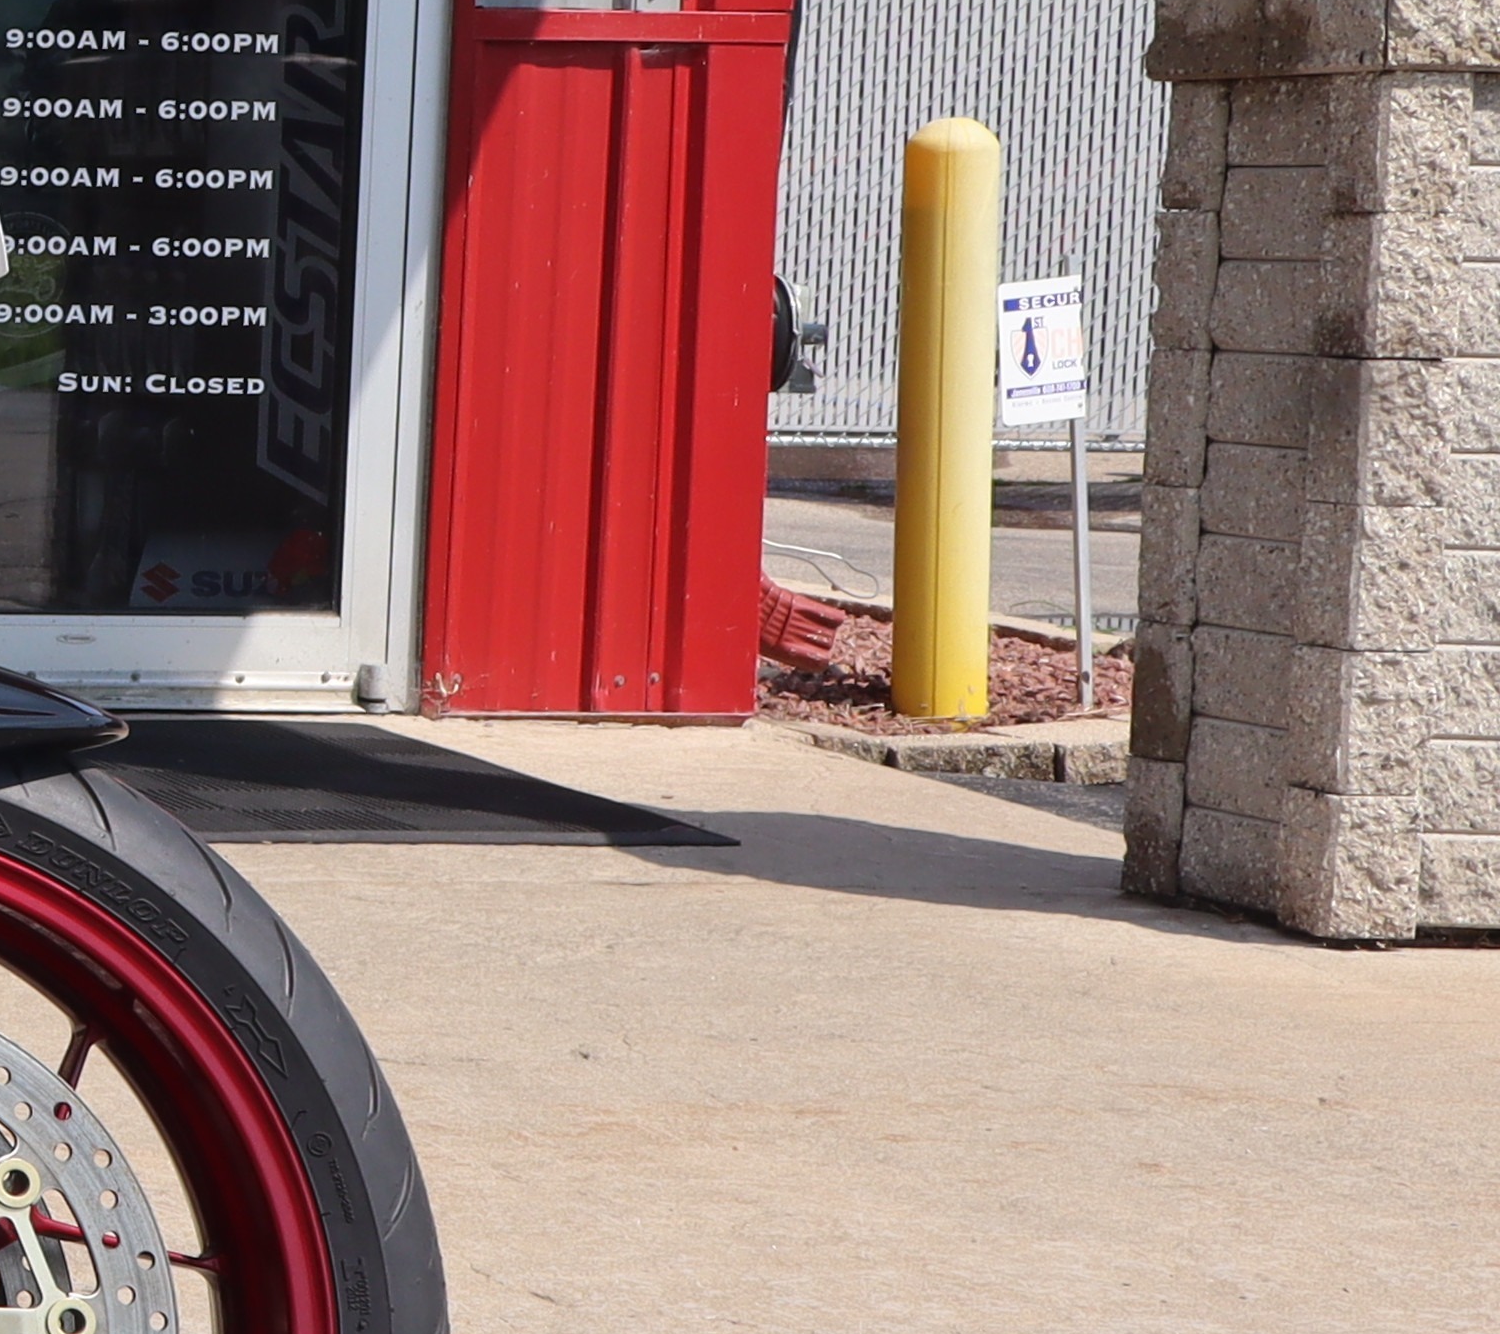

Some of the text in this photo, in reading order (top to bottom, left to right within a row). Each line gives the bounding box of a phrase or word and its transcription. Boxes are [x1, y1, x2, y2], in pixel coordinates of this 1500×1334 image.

[6, 28, 125, 50] 9:00AM
[161, 31, 279, 54] 6:00PM
[3, 97, 123, 119] 9:00AM
[158, 100, 276, 121] 6:00PM
[0, 166, 120, 188] 9:00AM
[155, 168, 273, 190] 6:00PM
[4, 235, 117, 257] 9:00AM
[152, 237, 270, 258] 6:00PM
[259, 0, 350, 500] ECSTAR
[148, 305, 267, 327] 3:00PM
[1052, 358, 1078, 370] LOCK
[14, 831, 188, 949] DUNLOP
